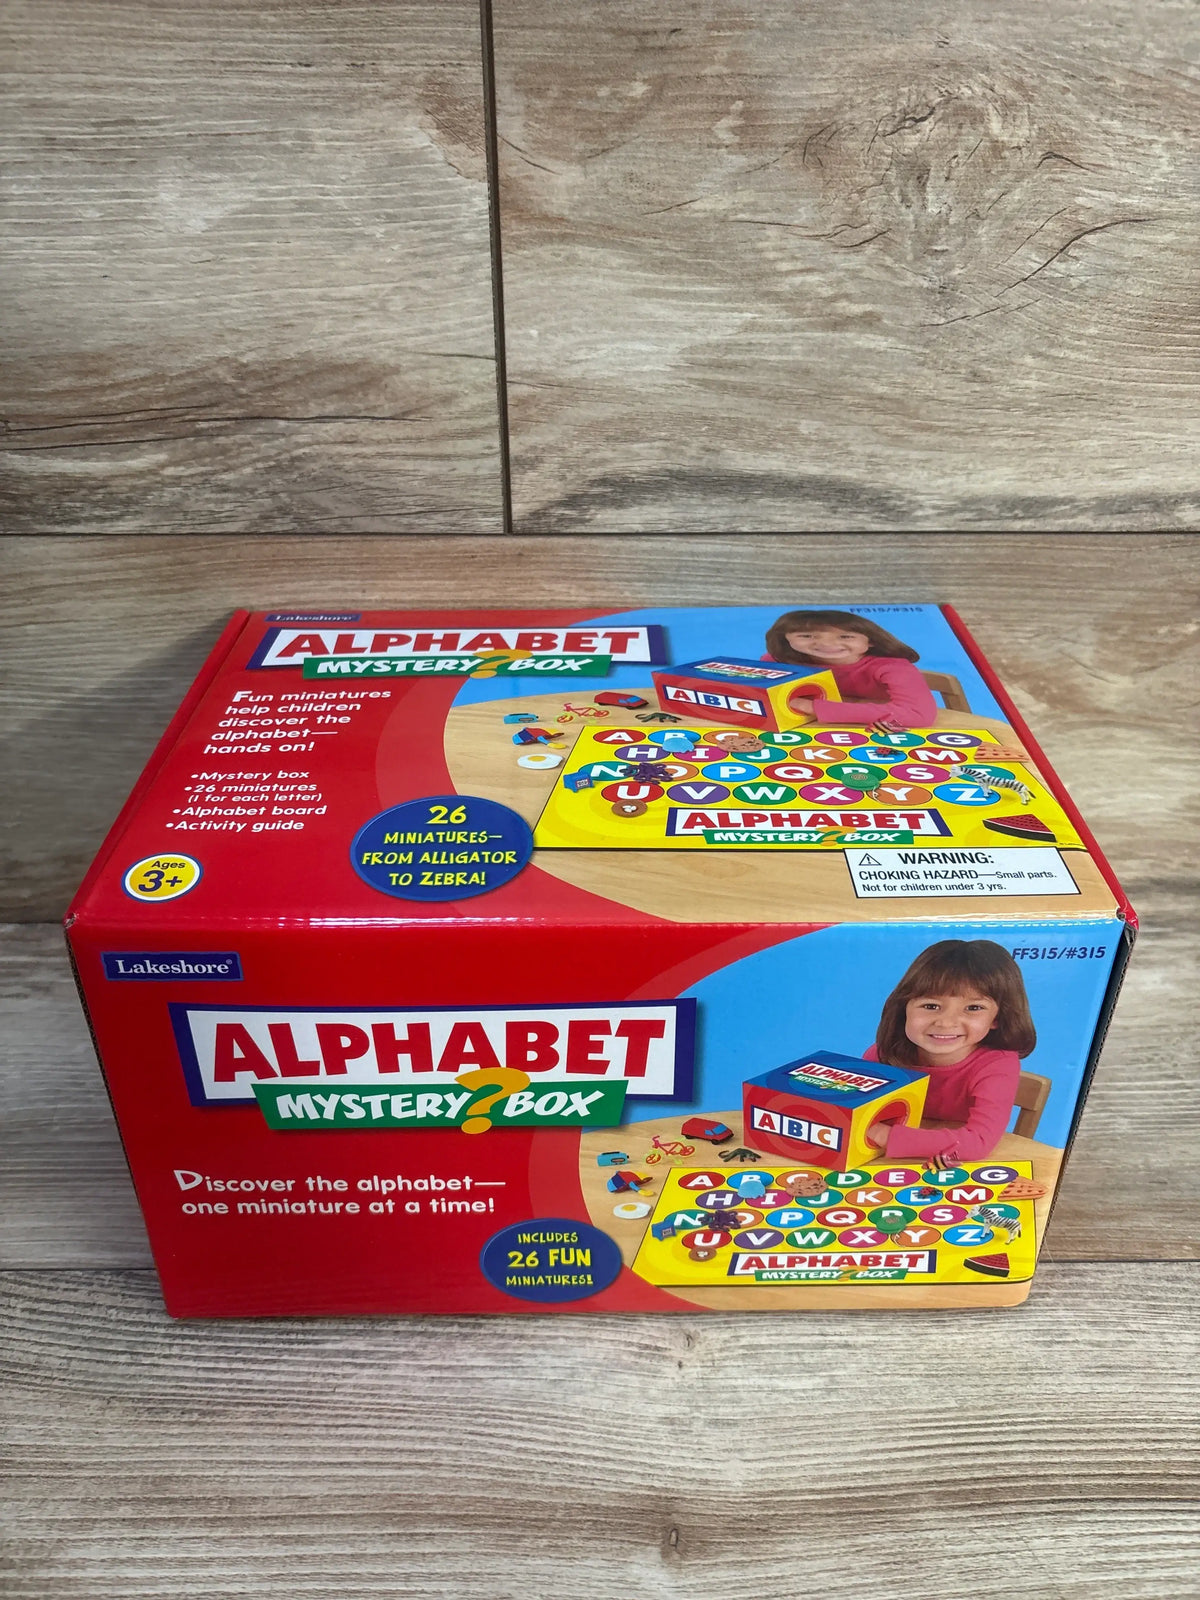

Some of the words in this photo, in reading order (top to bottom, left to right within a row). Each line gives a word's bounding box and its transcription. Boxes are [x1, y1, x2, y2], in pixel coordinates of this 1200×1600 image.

[276, 632, 640, 657] ALPHABET
[317, 658, 484, 674] MYSTERY
[507, 658, 593, 672] BOX
[232, 690, 273, 702] Fun
[280, 690, 392, 701] miniatures
[224, 705, 270, 716] help
[276, 702, 362, 713] children
[218, 717, 308, 728] discover
[316, 714, 352, 724] the
[602, 732, 634, 742] A
[773, 733, 802, 743] D
[830, 734, 852, 744] E
[888, 733, 908, 744] F
[936, 734, 972, 745] G
[203, 742, 272, 754] hands
[278, 742, 315, 752] on!
[626, 748, 658, 759] H
[692, 748, 710, 759] I
[746, 748, 771, 760] J
[802, 748, 836, 760] K
[914, 750, 960, 762] M
[277, 770, 310, 780] box
[720, 766, 746, 778] P
[774, 766, 816, 780] Q
[906, 767, 934, 780] S
[222, 783, 318, 792] miniatures
[616, 786, 650, 800] U
[680, 786, 717, 800] V
[740, 786, 788, 800] W
[813, 786, 854, 801] X
[880, 787, 914, 801] Y
[949, 788, 988, 802] Z
[204, 794, 227, 802] for
[231, 793, 269, 802] each
[274, 792, 322, 802] letter)
[272, 805, 328, 816] board
[425, 804, 467, 824] 26
[251, 820, 305, 832] guide
[682, 812, 926, 830] ALPHABET
[714, 831, 825, 842] MYSTERY
[843, 832, 902, 842] BOX
[150, 860, 186, 870] Ages
[362, 852, 414, 866] FROM
[418, 850, 518, 865] ALLIGATOR
[896, 852, 995, 866] WARNING:
[138, 870, 182, 893] 3+
[388, 872, 413, 886] TO
[418, 871, 486, 886] ZEBRA!
[858, 870, 920, 880] CHOKING
[1027, 871, 1058, 880] parts.
[862, 884, 882, 892] Not
[882, 883, 898, 892] for
[900, 882, 942, 892] children
[944, 882, 976, 892] under
[976, 882, 985, 891] 3
[986, 883, 1007, 893] yrs.
[1012, 946, 1106, 960] FF315/#315
[214, 1020, 666, 1082] ALPHABET
[276, 1092, 474, 1120] MYSTERY
[502, 1090, 605, 1118] BOX
[758, 1112, 776, 1131] A
[788, 1119, 803, 1137] B
[817, 1128, 832, 1146] C
[173, 1170, 296, 1192] Discover
[305, 1175, 348, 1191] the
[686, 1175, 714, 1187] A
[836, 1173, 862, 1185] D
[888, 1172, 906, 1184] E
[938, 1170, 955, 1182] F
[980, 1169, 1010, 1182] G
[706, 1194, 734, 1206] H
[760, 1192, 778, 1205] I
[808, 1192, 830, 1204] J
[856, 1190, 883, 1204] K
[952, 1188, 986, 1200] M
[182, 1202, 230, 1214] one
[237, 1198, 360, 1214] miniature
[368, 1198, 396, 1214] at
[404, 1202, 420, 1214] a
[430, 1198, 495, 1214] time!
[780, 1212, 804, 1224] P
[825, 1210, 857, 1224] Q
[932, 1208, 954, 1222] S
[518, 1232, 578, 1244] INCLUDES
[694, 1234, 722, 1246] U
[746, 1232, 775, 1246] V
[793, 1232, 830, 1244] W
[848, 1230, 878, 1244] X
[903, 1229, 931, 1243] Y
[956, 1228, 982, 1242] Z
[507, 1250, 540, 1268] 26
[548, 1248, 592, 1267] FUN
[740, 1254, 925, 1270] ALPHABET
[506, 1274, 594, 1286] MINIATURES!
[762, 1270, 844, 1280] MYSTERY
[855, 1270, 899, 1278] BOX
